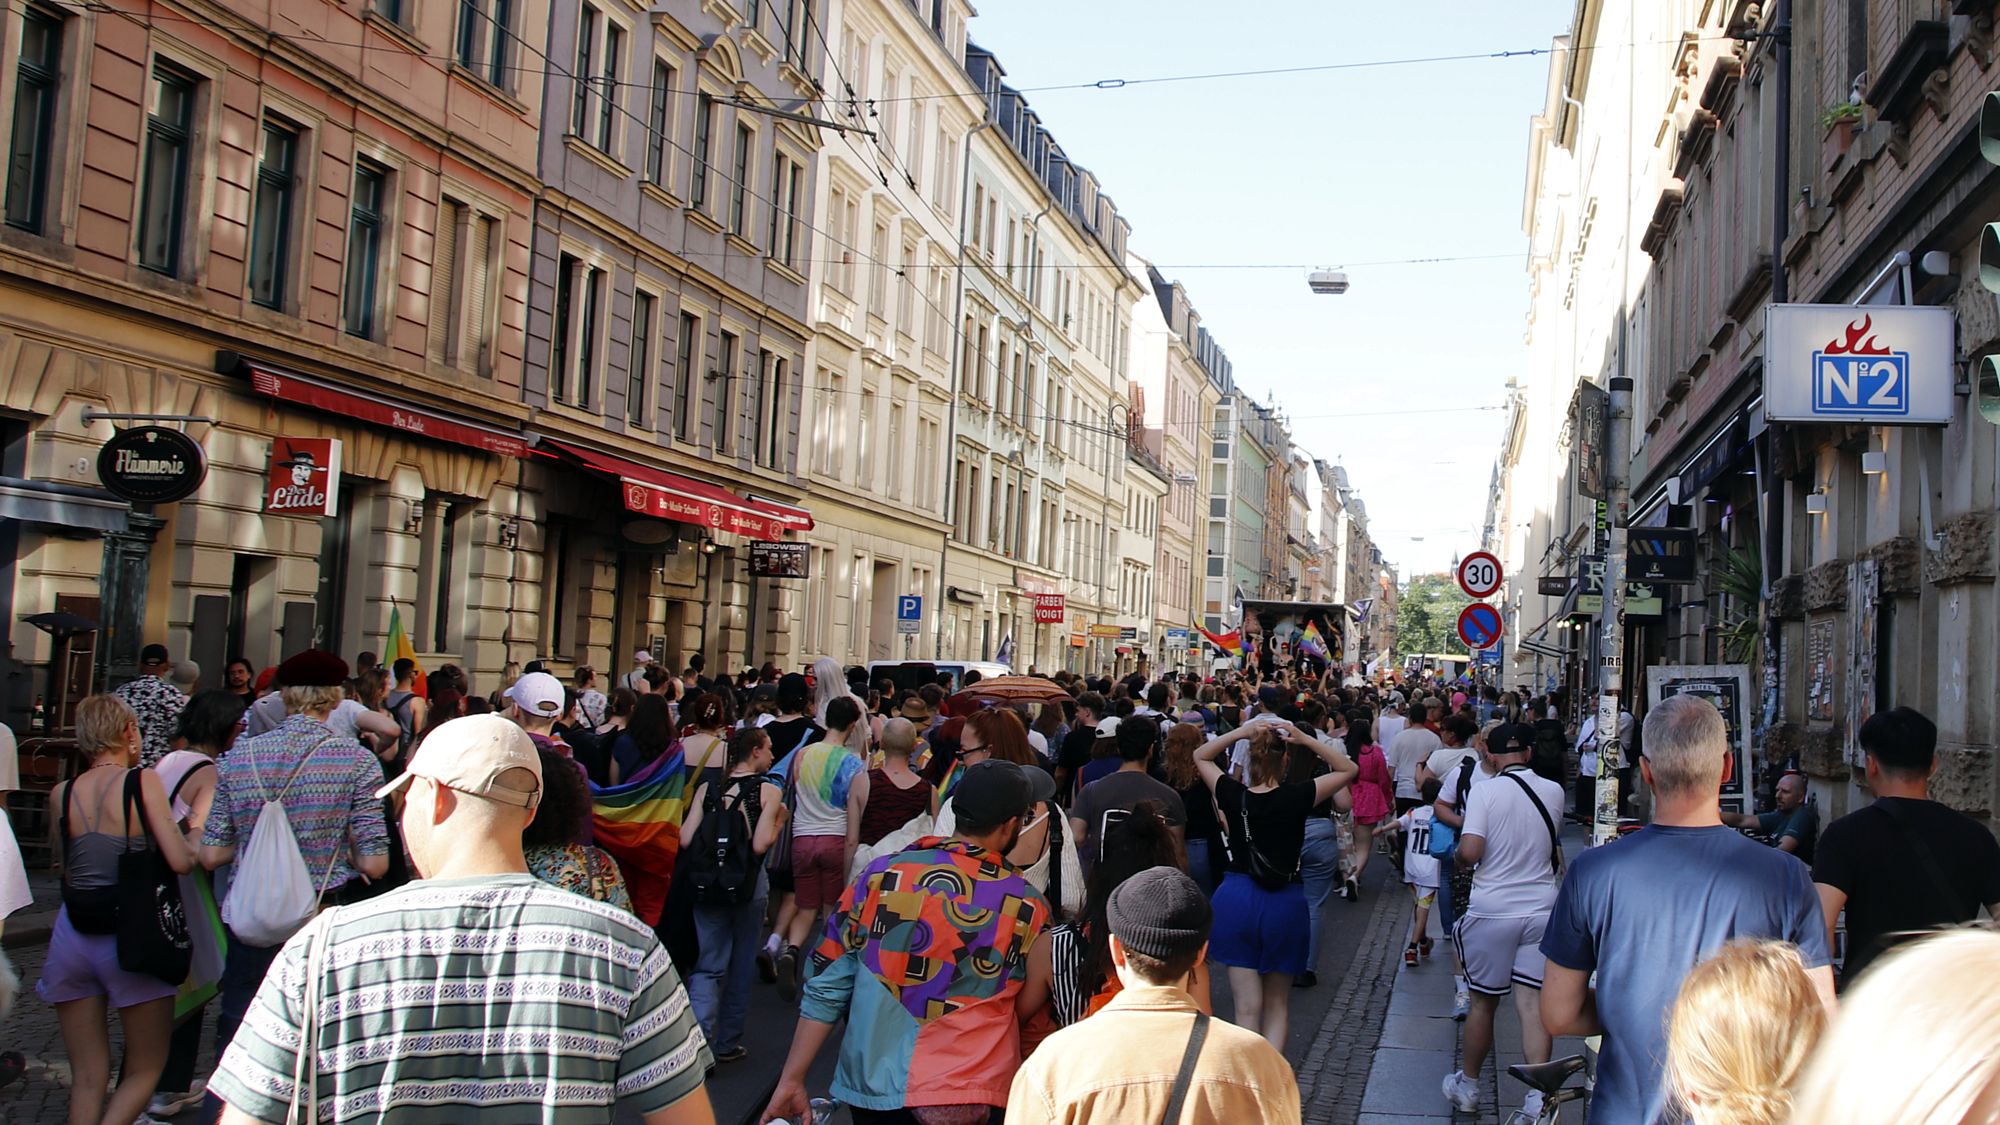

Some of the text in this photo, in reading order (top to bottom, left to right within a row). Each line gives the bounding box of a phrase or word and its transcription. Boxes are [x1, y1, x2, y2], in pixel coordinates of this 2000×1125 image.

[287, 484, 307, 496] Der
[1468, 564, 1493, 585] 30
[903, 598, 916, 617] P
[1036, 596, 1063, 606] FARBEN
[1035, 609, 1063, 619] VOIGT
[1412, 828, 1430, 855] 10
